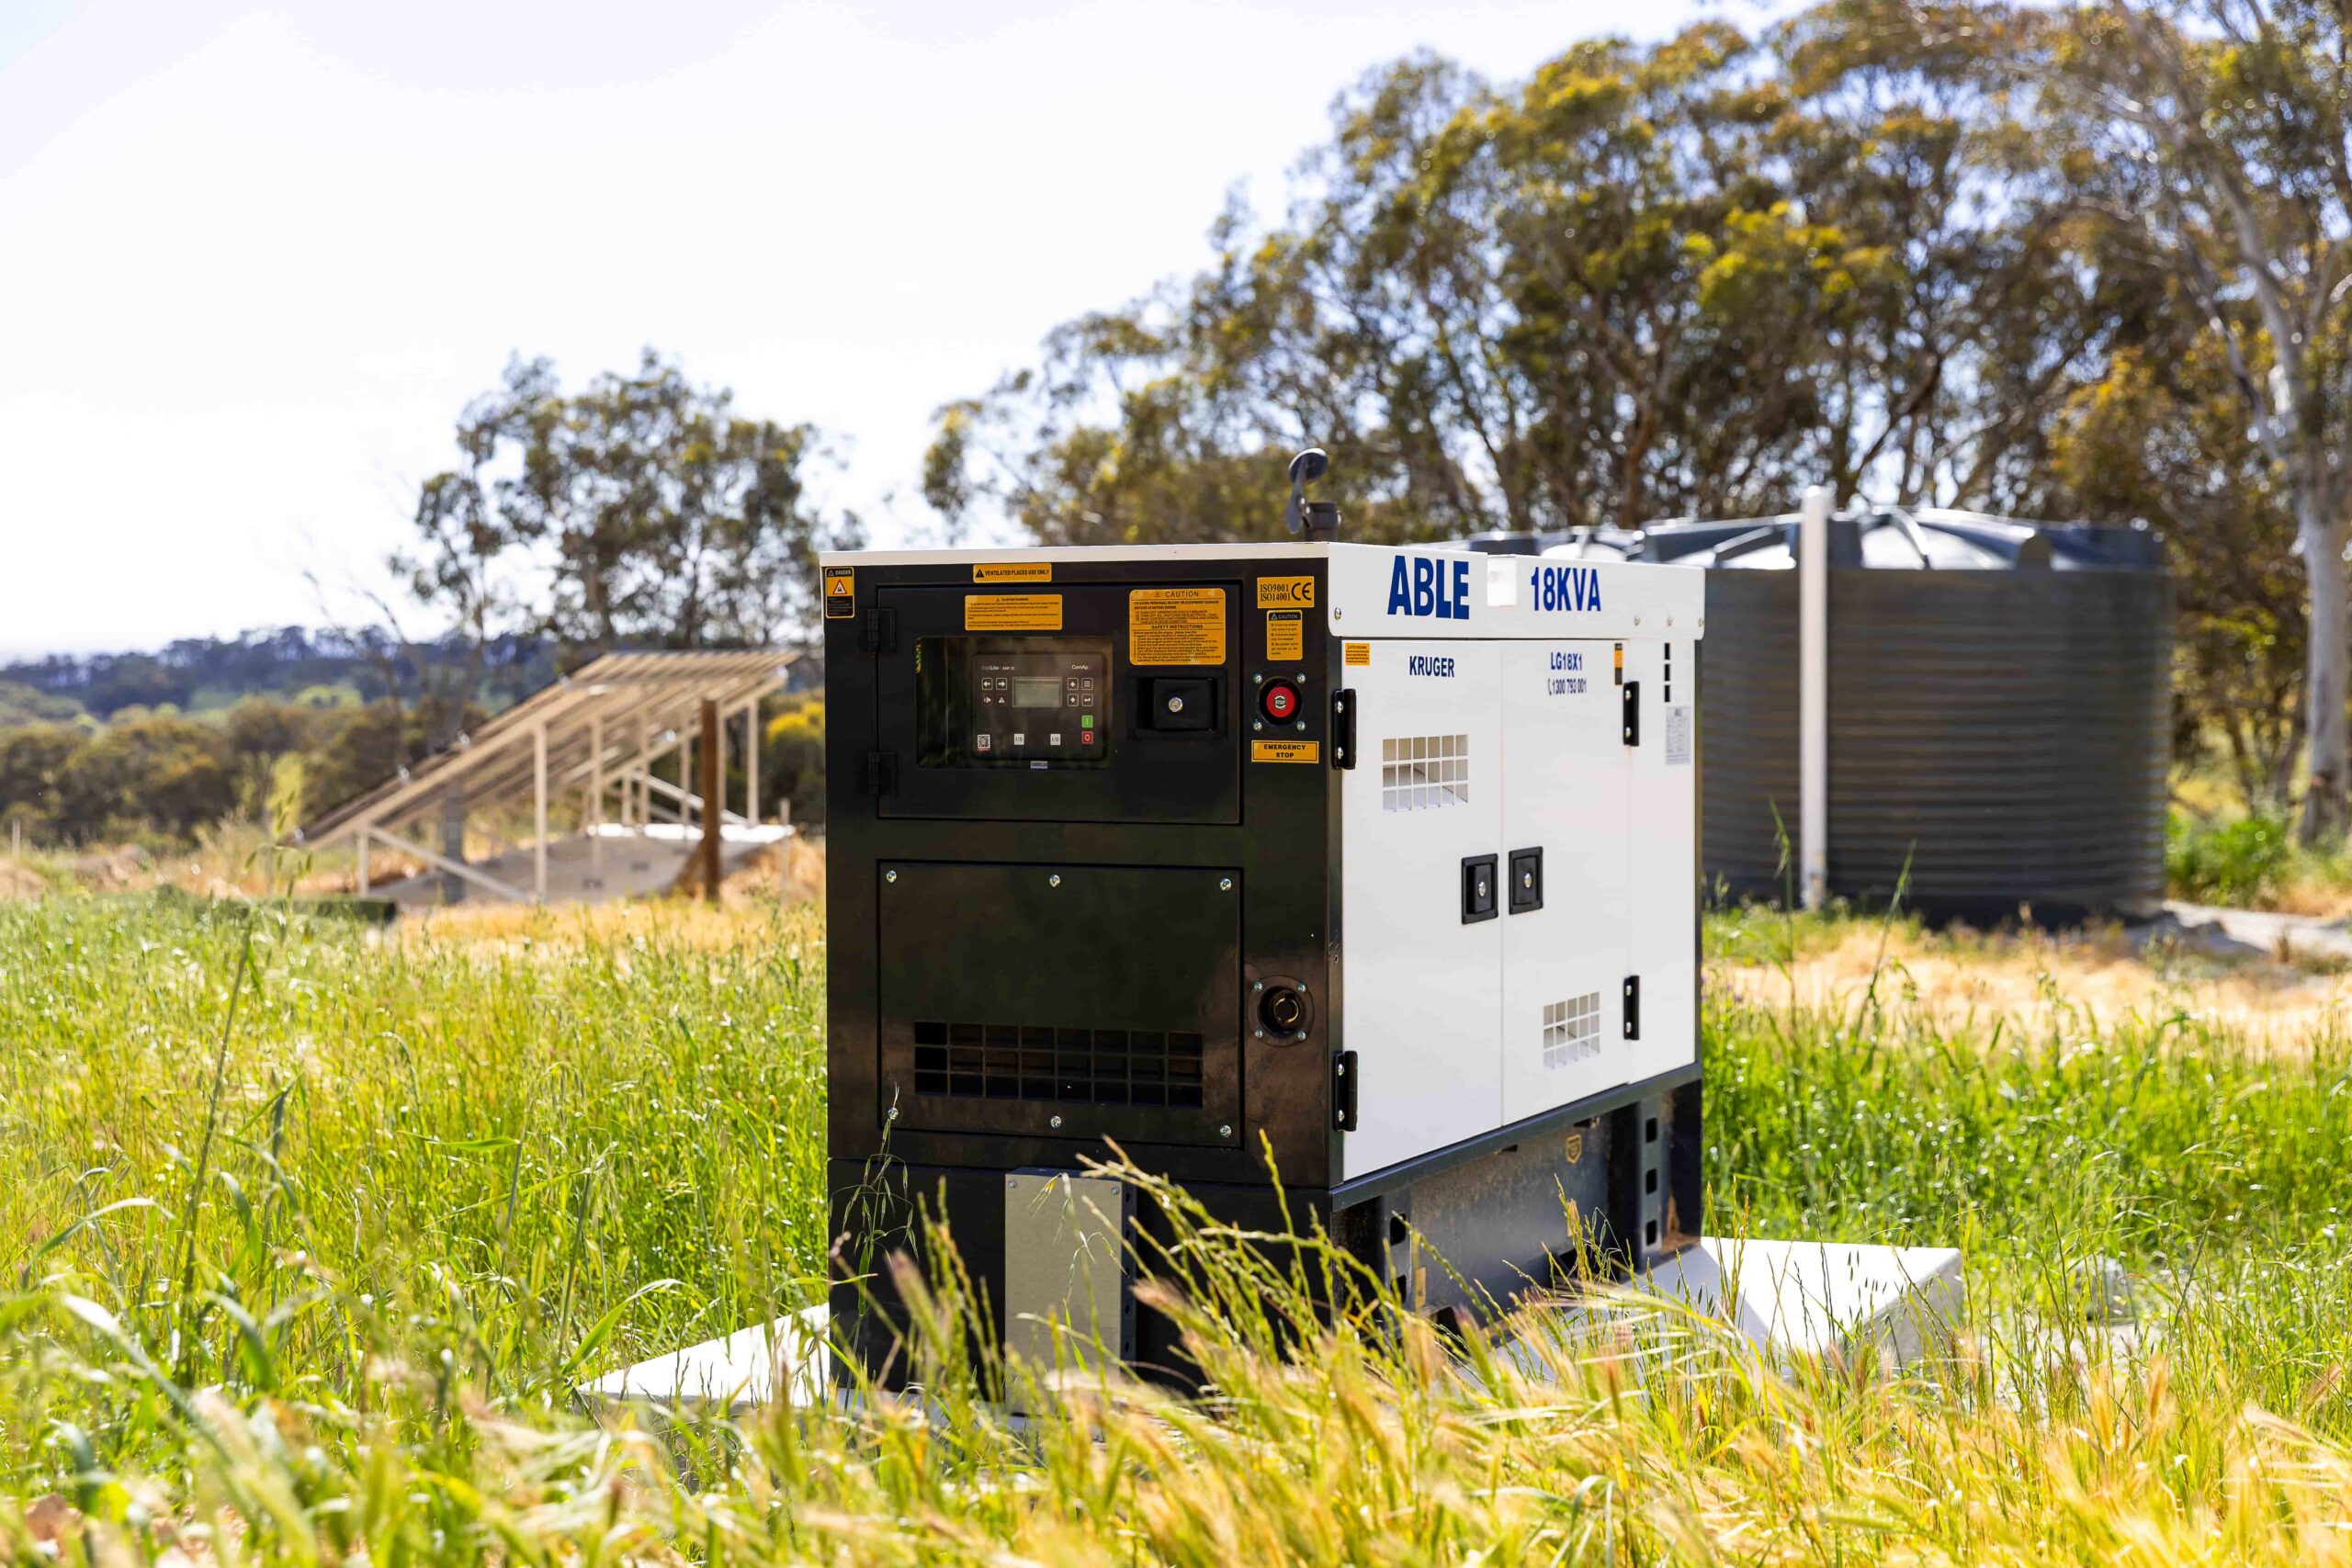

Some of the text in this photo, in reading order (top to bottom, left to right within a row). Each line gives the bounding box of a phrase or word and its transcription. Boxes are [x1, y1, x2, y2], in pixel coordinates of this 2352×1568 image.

[1261, 584, 1289, 592] ISO9001
[1261, 592, 1291, 602] ISO14001
[1387, 555, 1469, 620] ABLE
[1532, 567, 1601, 612] 18KVA
[1409, 656, 1455, 678] KRUGER
[1551, 652, 1582, 671] LG18X1
